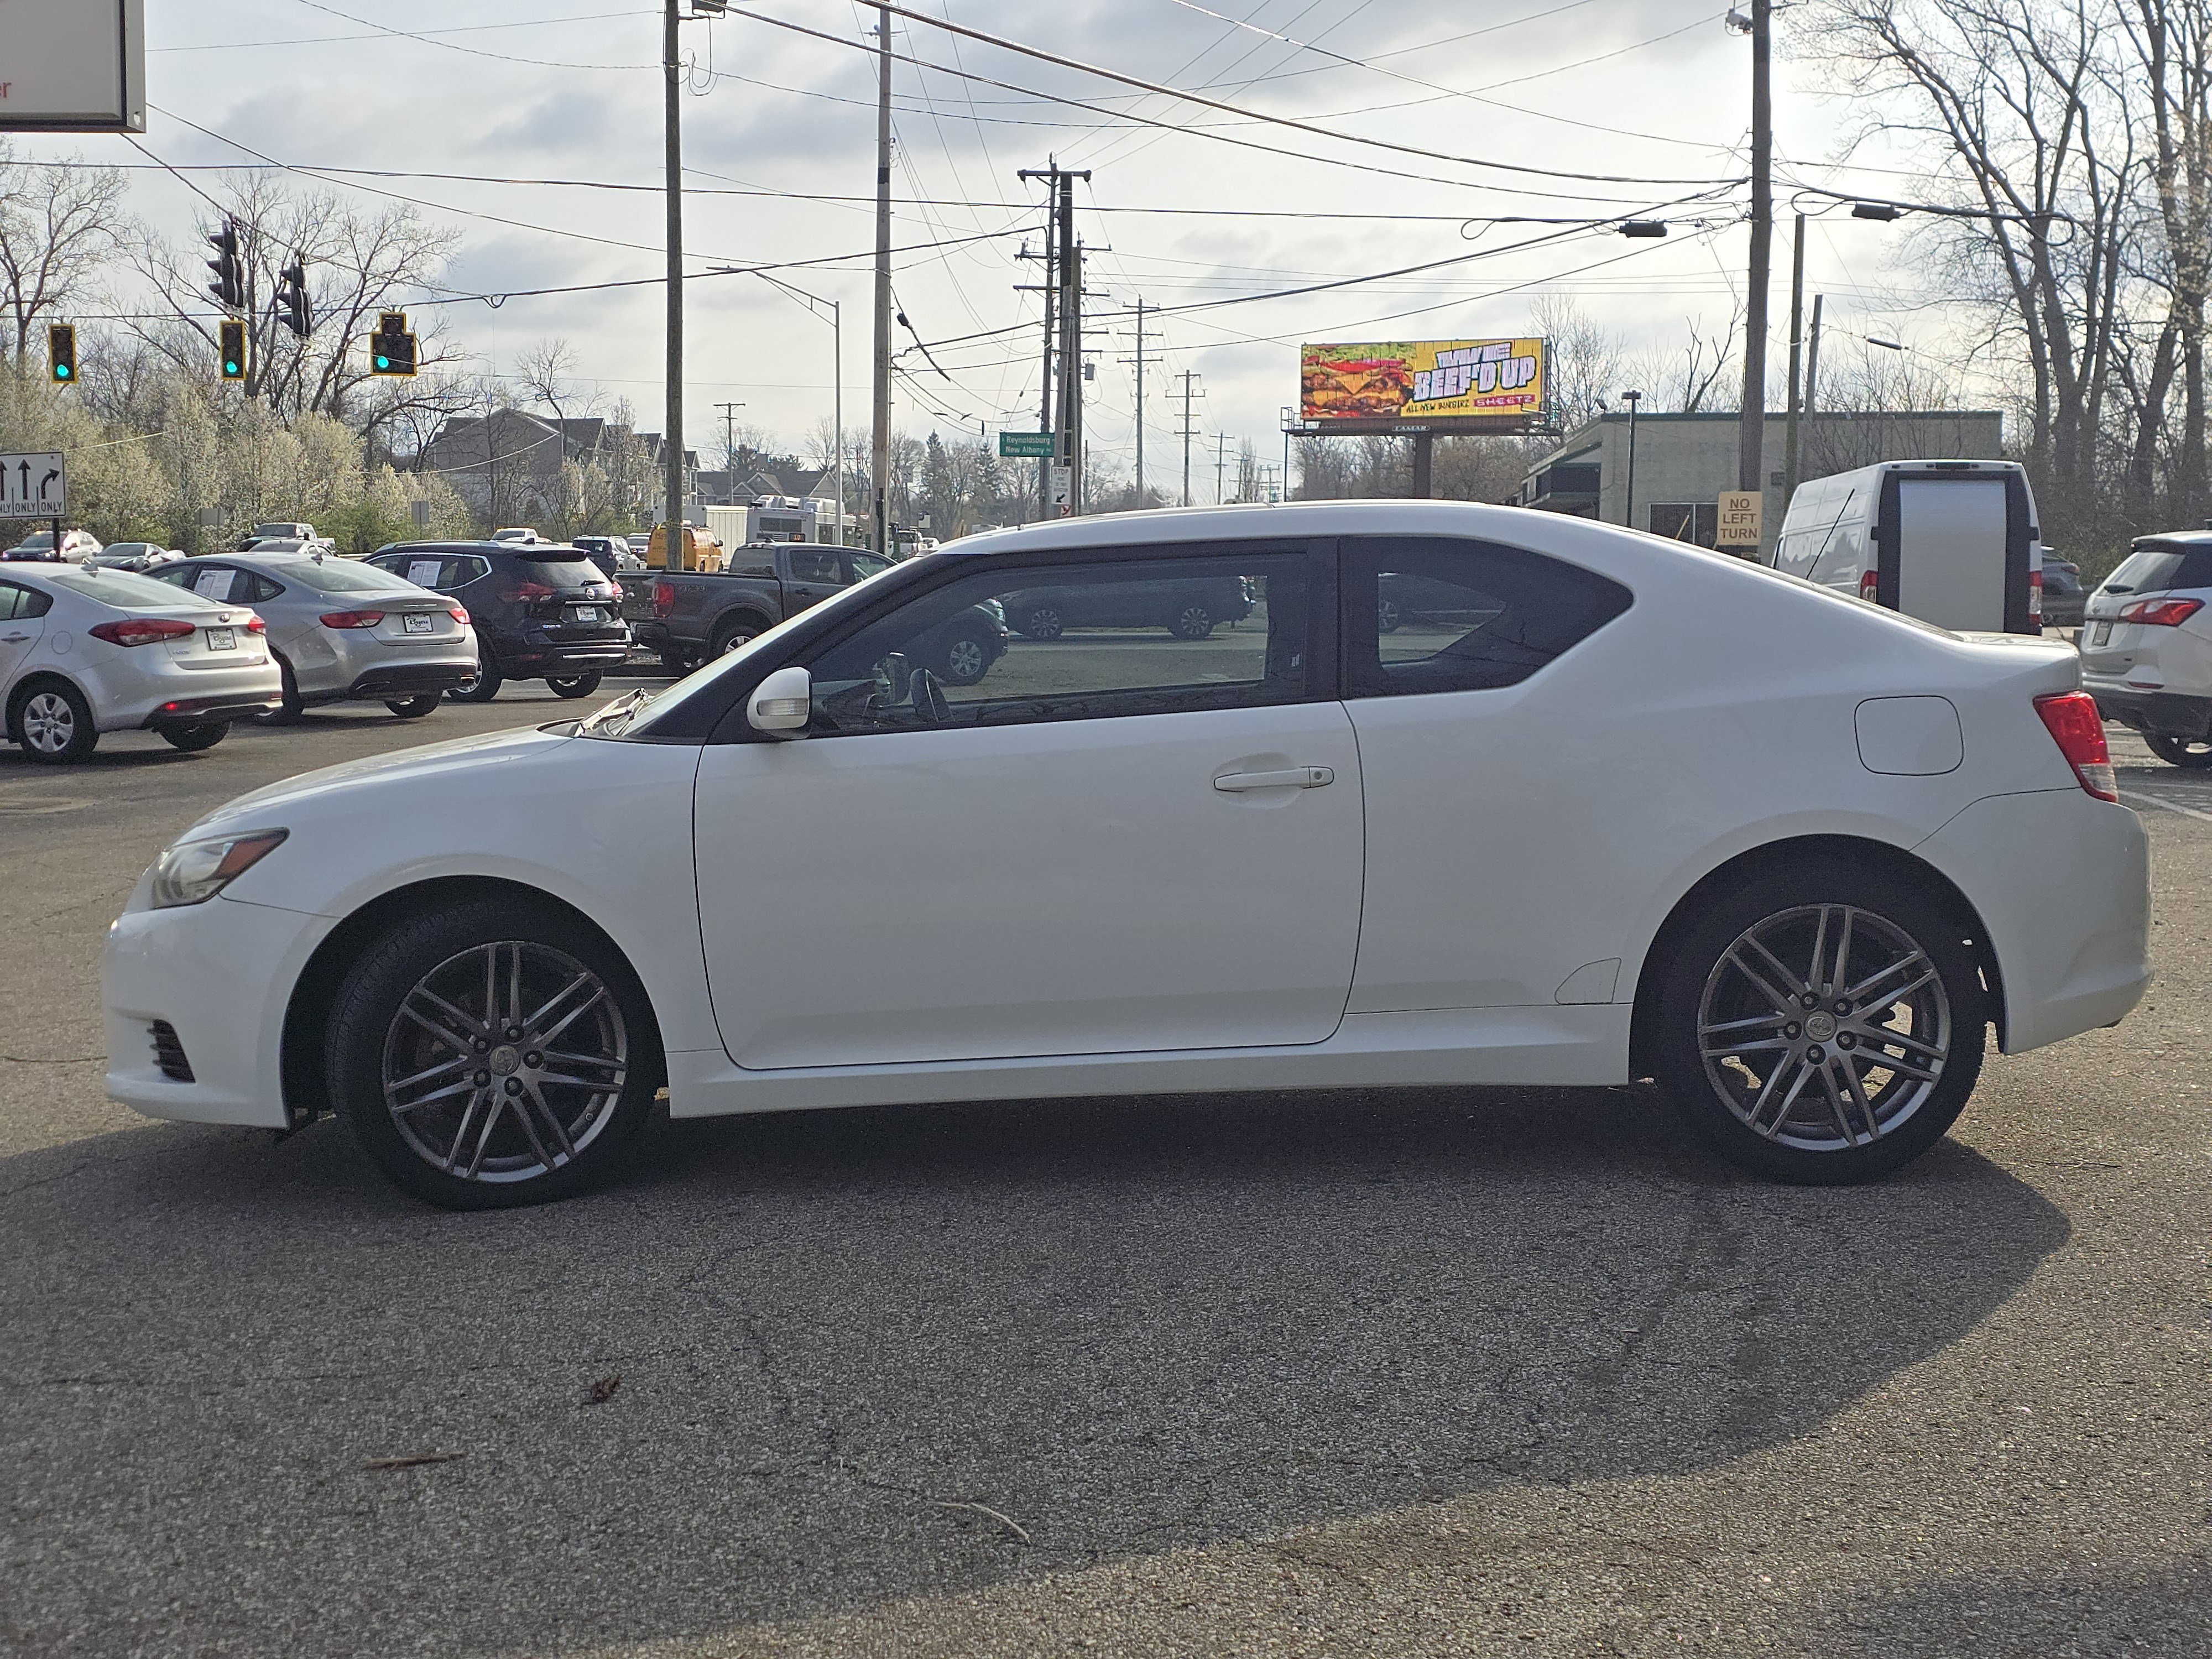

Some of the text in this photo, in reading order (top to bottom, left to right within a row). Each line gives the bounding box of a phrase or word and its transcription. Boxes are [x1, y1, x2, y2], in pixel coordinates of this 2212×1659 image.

[1412, 356, 1536, 401] BEEF'D UP
[1477, 395, 1532, 406] SHEETZ
[1006, 436, 1050, 445] Reynoldsburg
[1022, 446, 1044, 455] Albany
[15, 502, 36, 513] ONLY
[41, 501, 62, 512] ONLY
[1730, 498, 1750, 509] NO
[1723, 513, 1757, 524] LEFT
[1720, 528, 1757, 539] TURN
